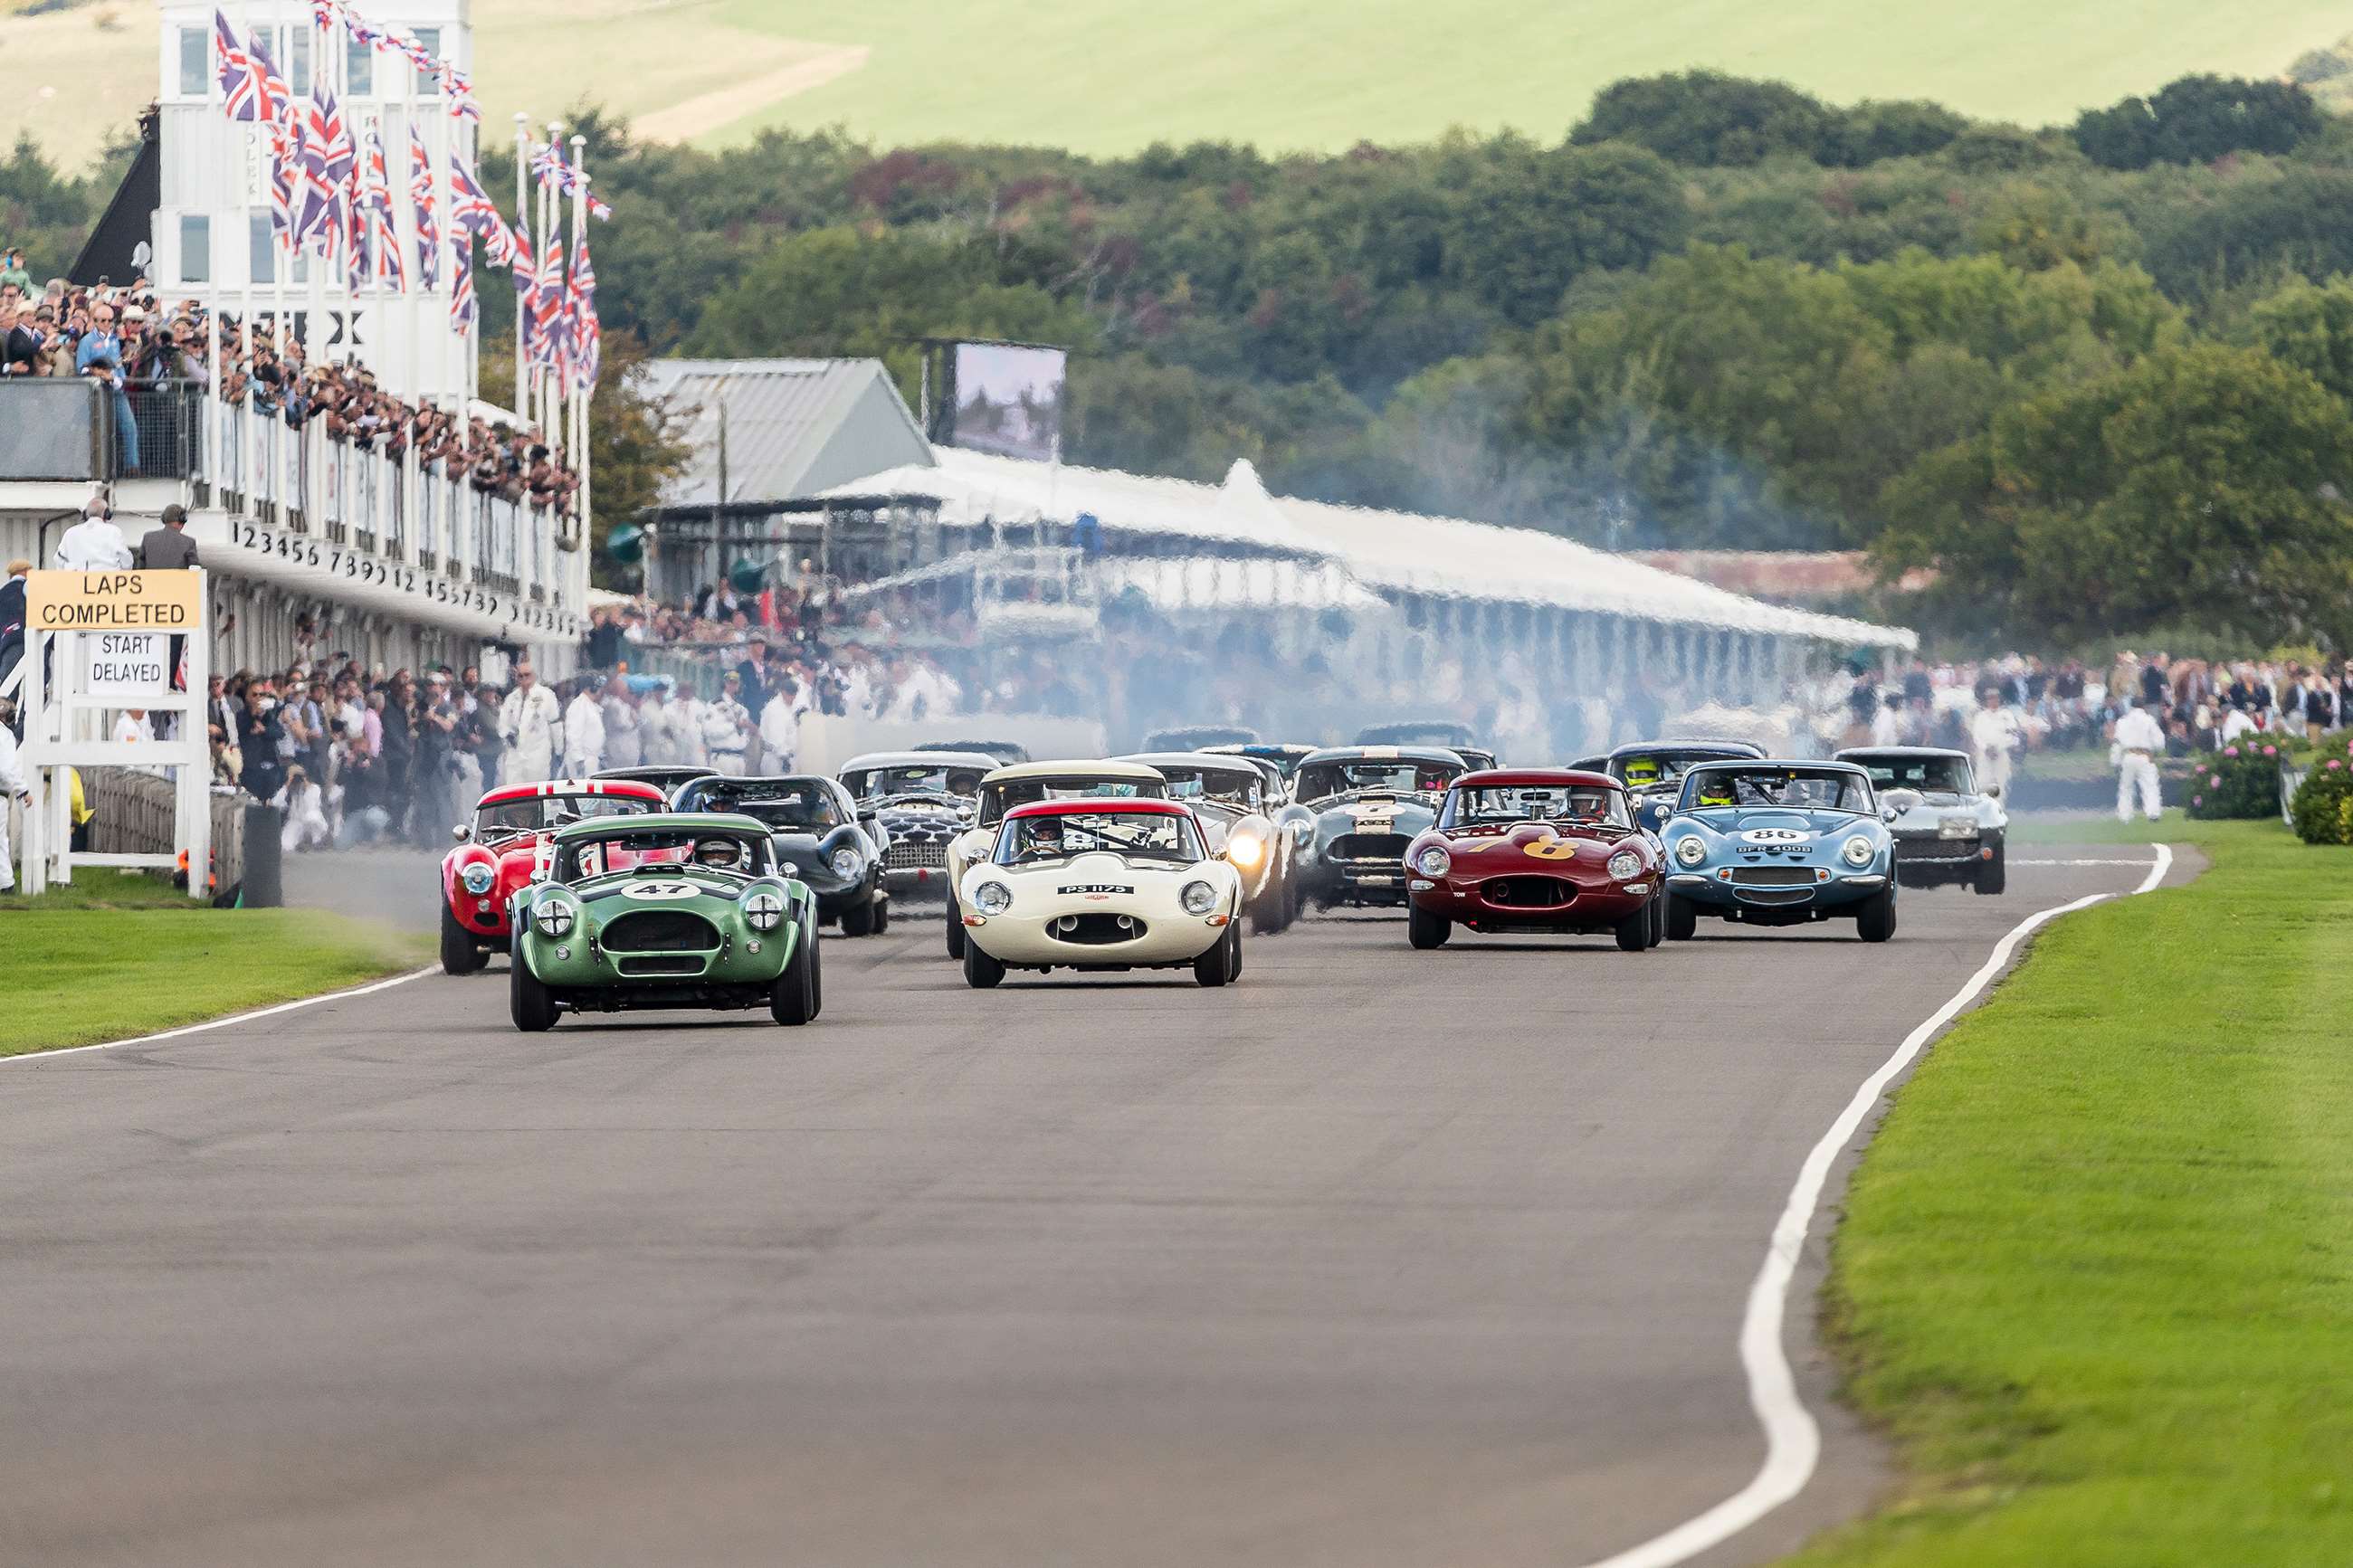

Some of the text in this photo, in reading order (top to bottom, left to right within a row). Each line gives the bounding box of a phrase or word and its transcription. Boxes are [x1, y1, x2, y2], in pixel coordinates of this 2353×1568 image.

[83, 575, 143, 594] LAPS
[43, 603, 186, 624] COMPLETED
[101, 634, 153, 654] START
[93, 662, 161, 682] DELAYED
[1754, 831, 1797, 840] 86
[634, 884, 689, 894] 47
[1065, 885, 1126, 893] PS 1175
